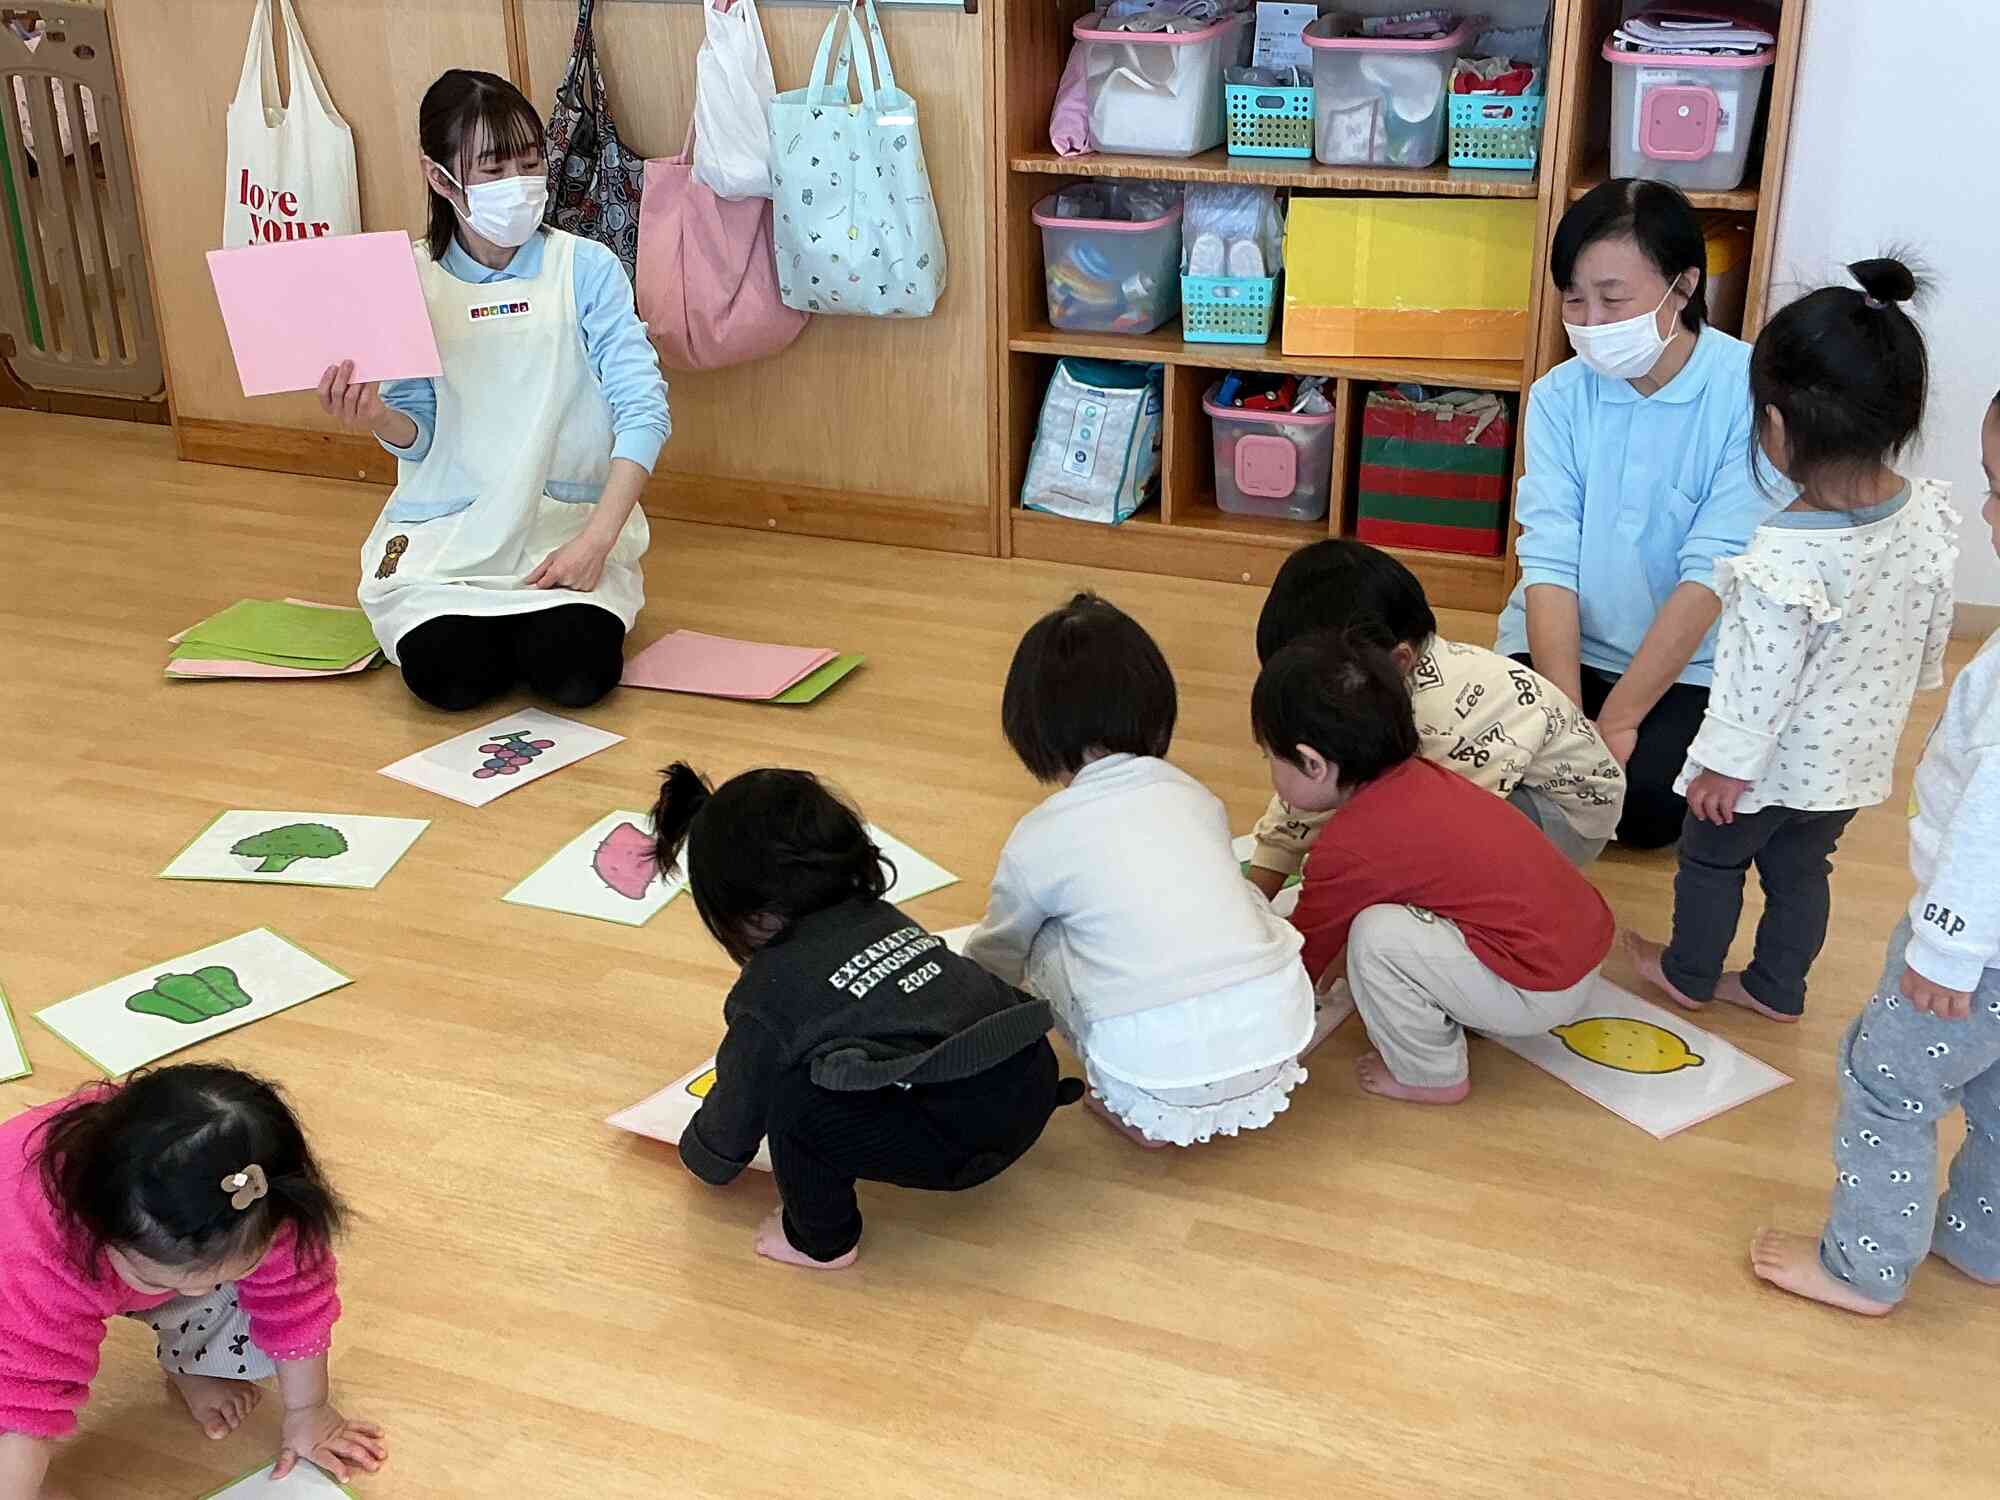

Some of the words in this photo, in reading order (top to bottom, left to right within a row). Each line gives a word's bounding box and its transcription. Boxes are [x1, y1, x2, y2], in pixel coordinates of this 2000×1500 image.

[240, 169, 298, 217] love
[248, 213, 330, 246] your
[1454, 684, 1485, 720] Lee
[1508, 669, 1536, 706] Lee
[1448, 736, 1490, 768] Lee
[1923, 903, 1966, 936] GAP
[897, 960, 943, 994] 2020
